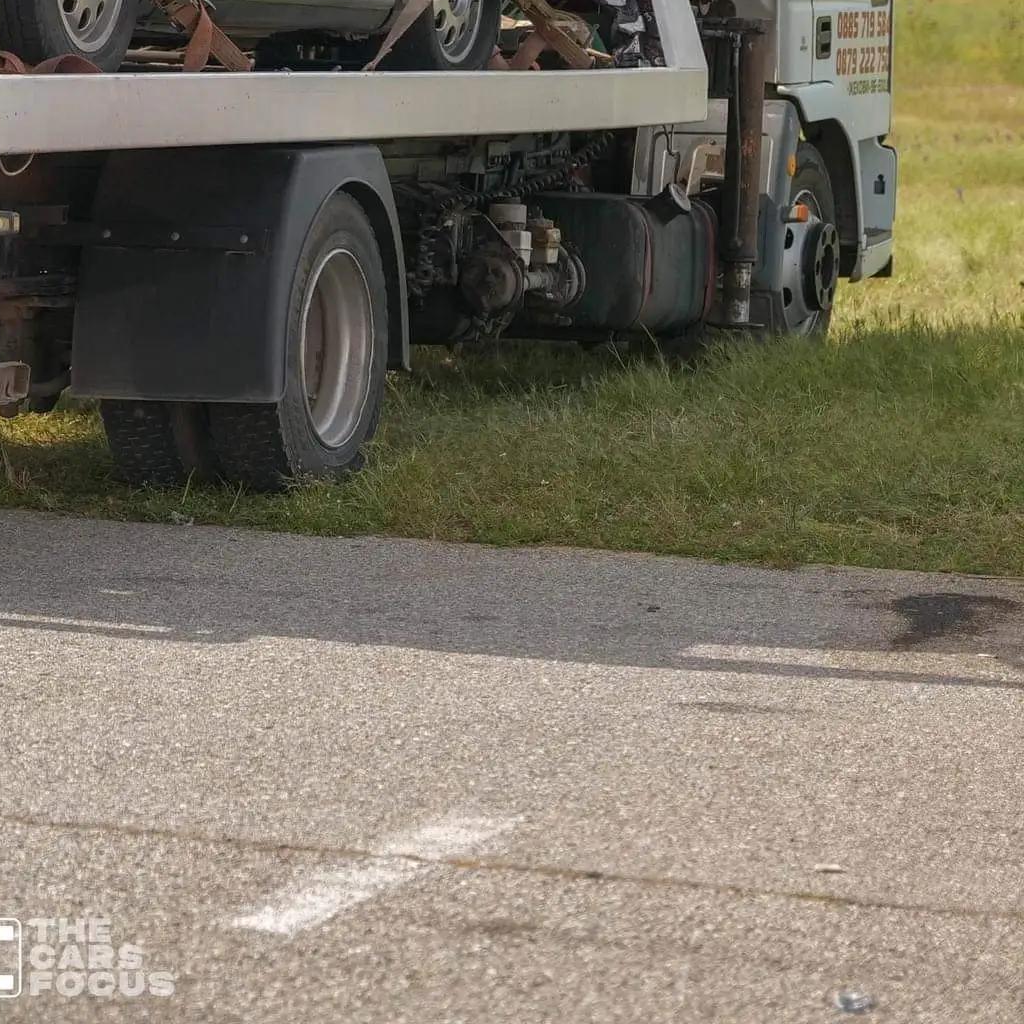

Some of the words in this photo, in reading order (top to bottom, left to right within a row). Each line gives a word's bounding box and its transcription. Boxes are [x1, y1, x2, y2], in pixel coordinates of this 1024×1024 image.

[837, 11, 859, 40] 0885
[861, 10, 876, 39] 719
[836, 47, 858, 75] 0879
[859, 46, 876, 74] 222
